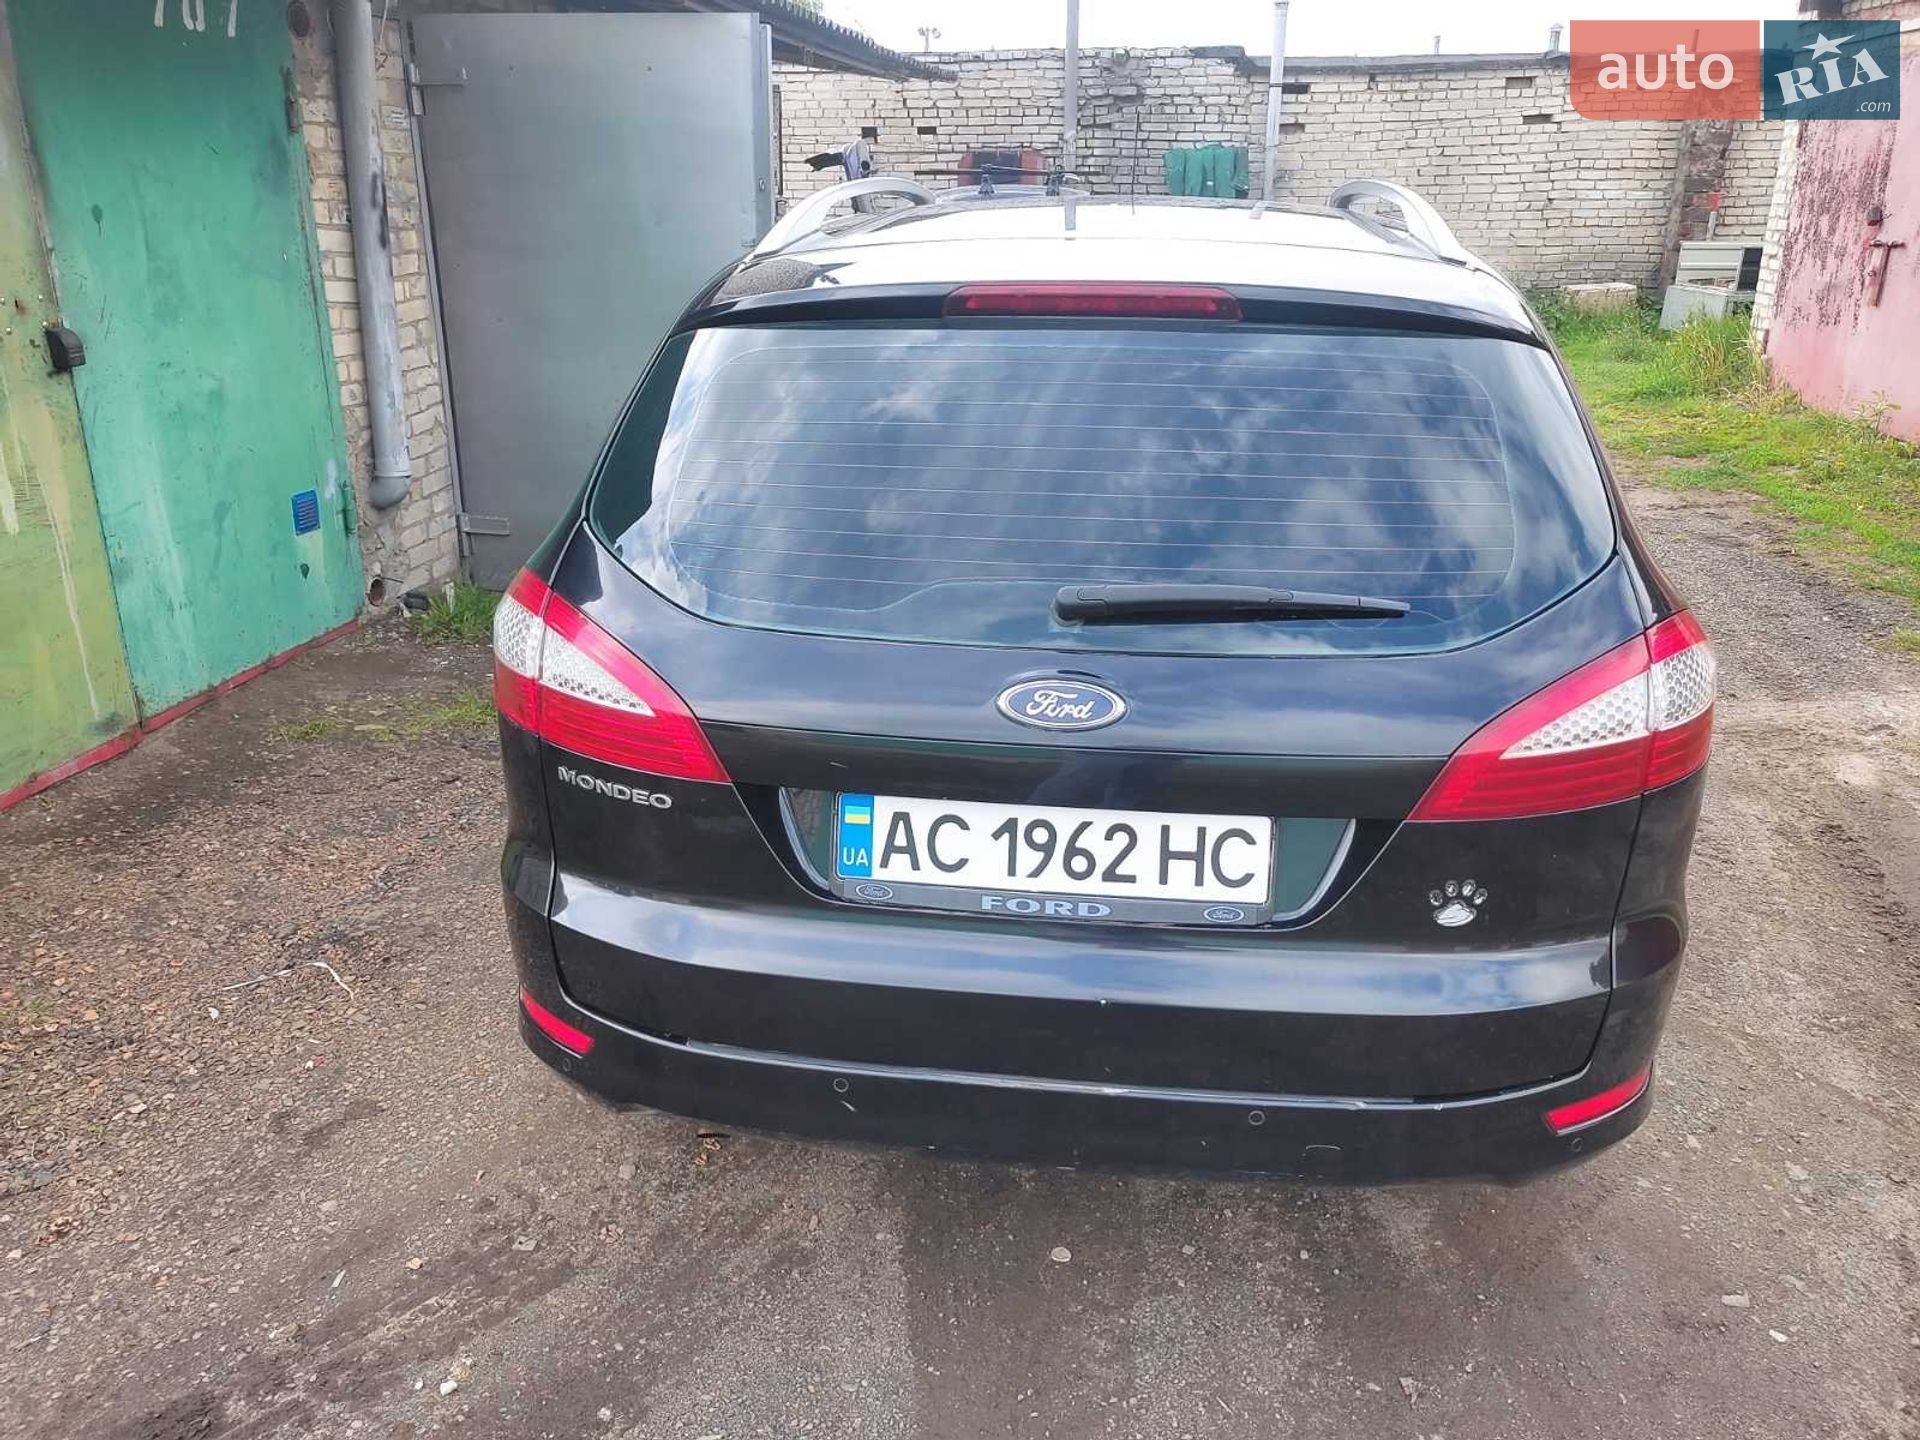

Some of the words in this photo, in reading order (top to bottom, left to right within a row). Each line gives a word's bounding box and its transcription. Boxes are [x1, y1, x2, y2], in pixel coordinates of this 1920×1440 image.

[1026, 690, 1095, 719] Ford
[558, 765, 672, 809] MONDEO
[843, 847, 869, 867] UA
[879, 811, 970, 873] AC
[991, 817, 1137, 884] 1962
[1159, 824, 1257, 888] HC
[981, 895, 1111, 917] FORD
